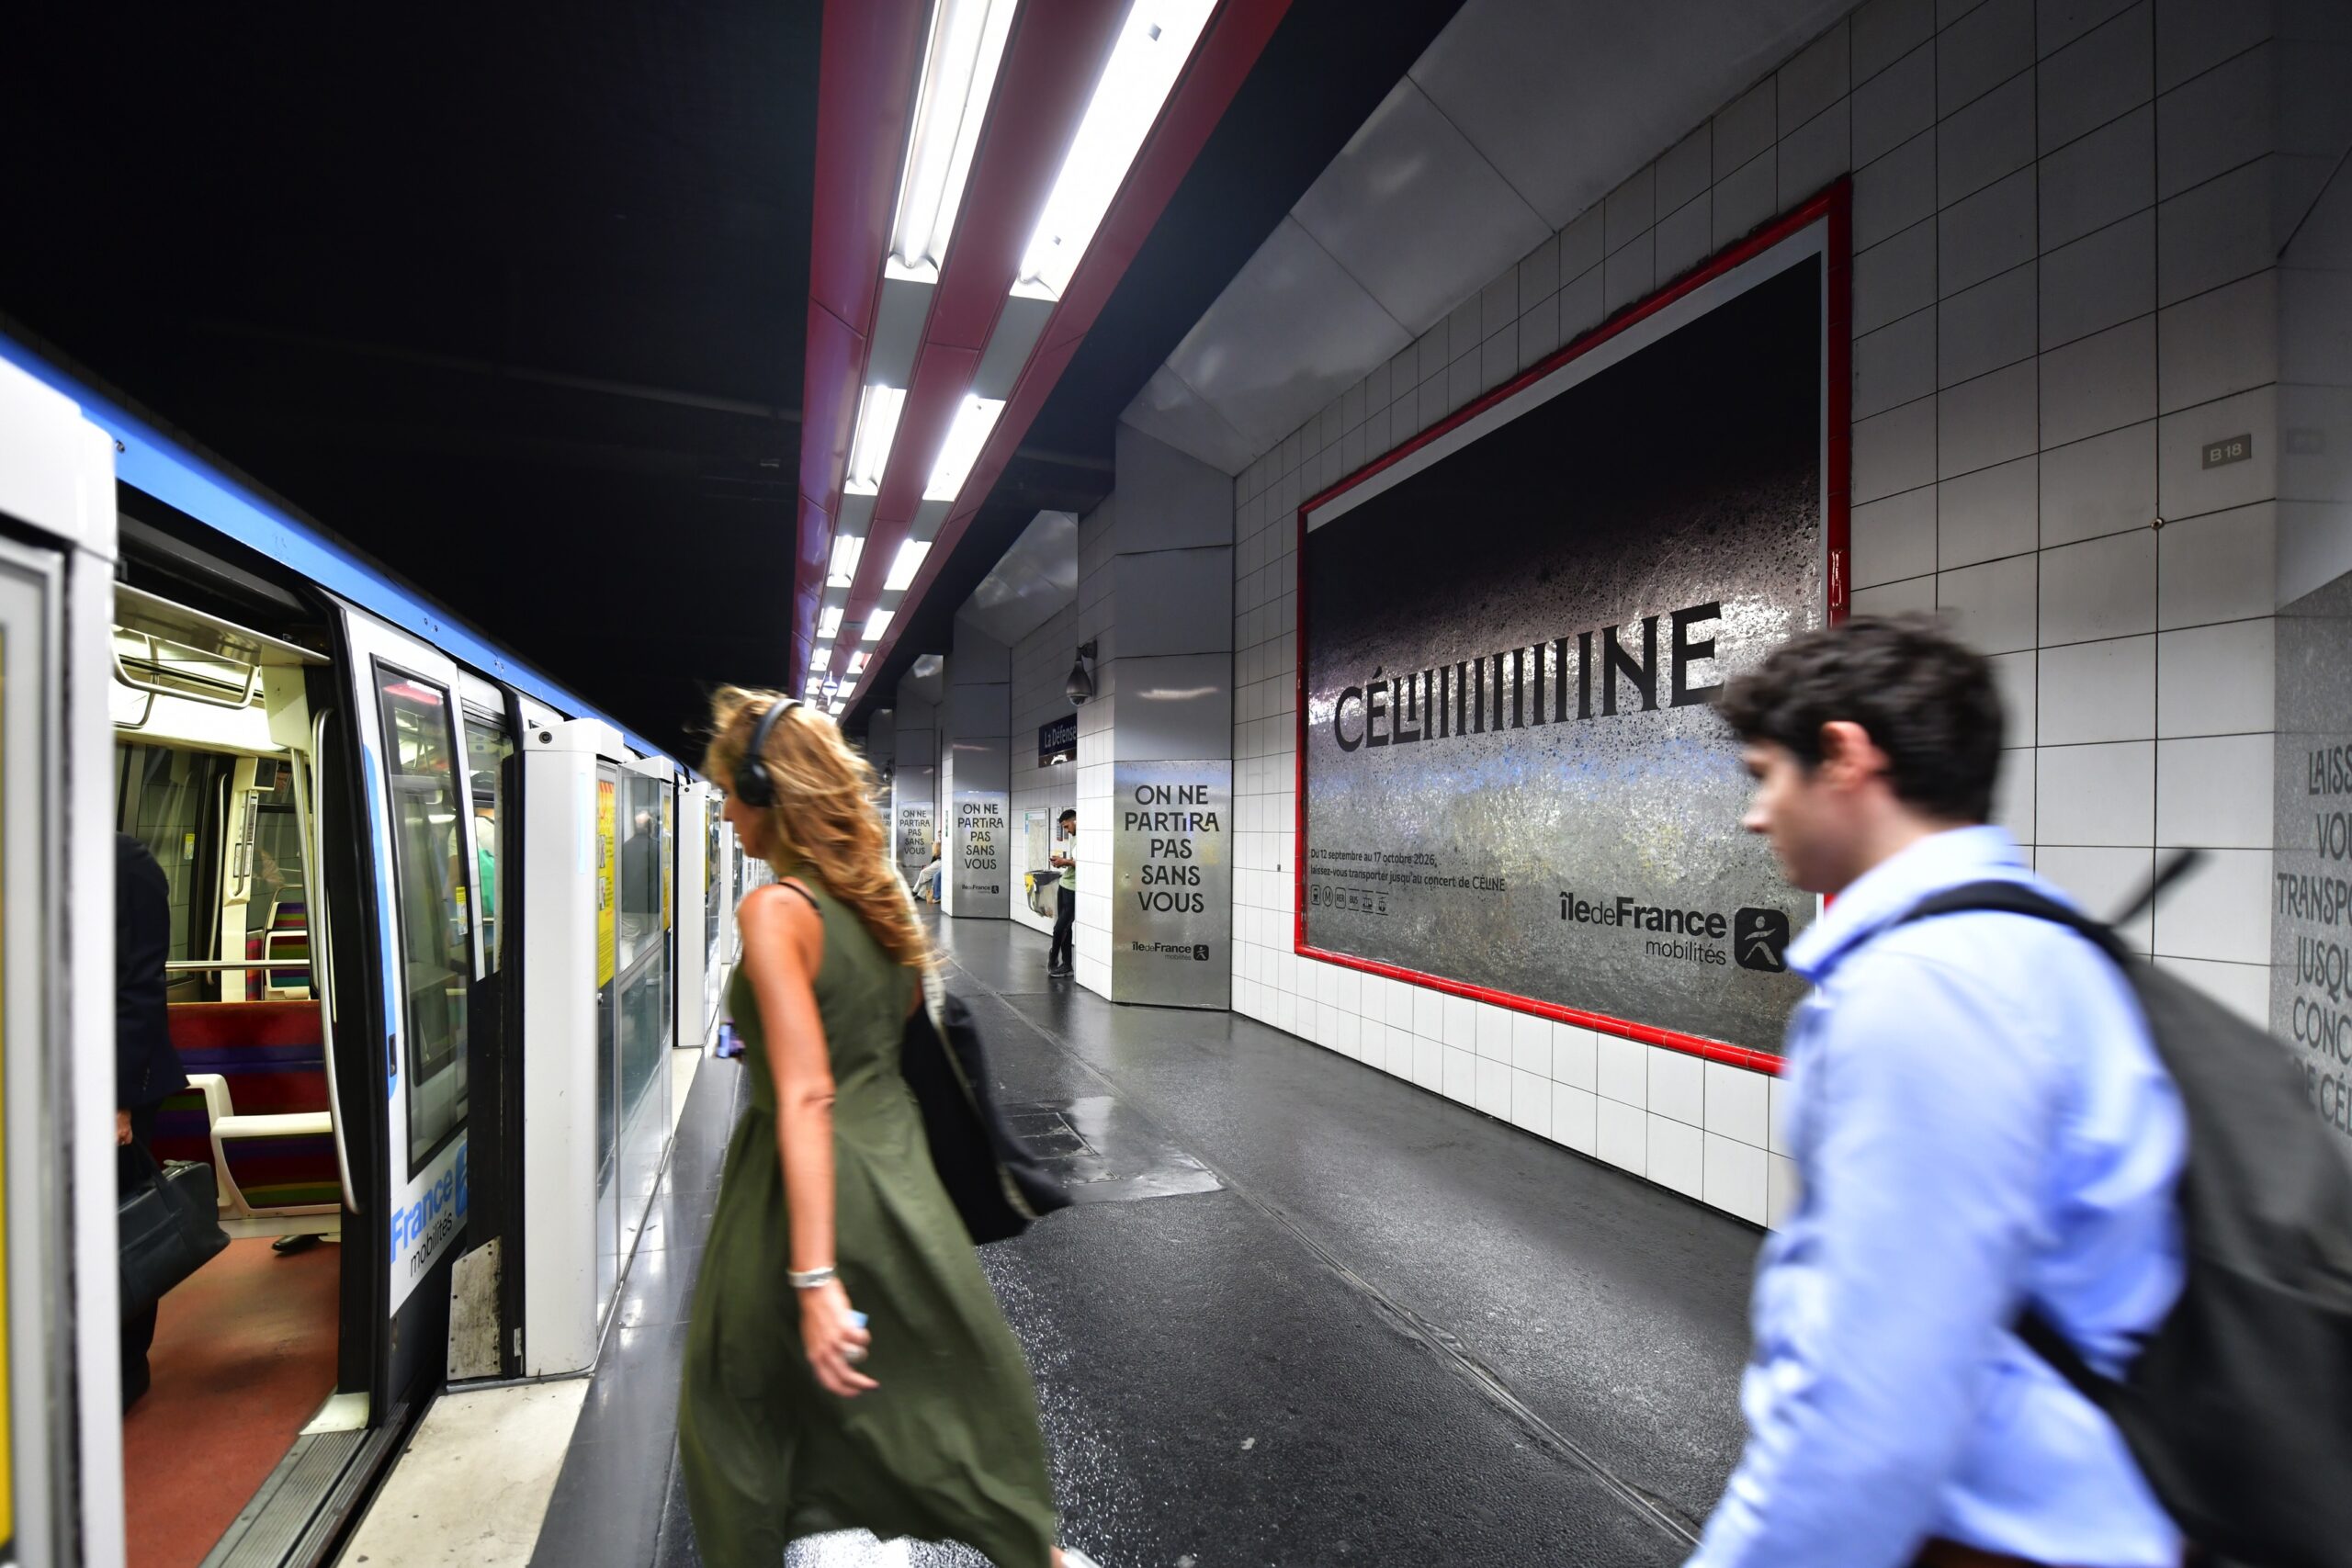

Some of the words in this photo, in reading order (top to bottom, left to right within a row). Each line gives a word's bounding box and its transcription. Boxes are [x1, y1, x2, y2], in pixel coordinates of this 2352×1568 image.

[2211, 448, 2222, 462] B
[2225, 443, 2243, 457] 18
[1045, 731, 1052, 749] La
[1052, 724, 1077, 746] Défense
[1135, 785, 1170, 805] ON
[1179, 785, 1208, 805] NE
[963, 804, 980, 814] ON
[984, 804, 998, 814] NE
[957, 818, 1004, 829] PARTIRA
[1125, 812, 1220, 832] PARTIRA
[905, 838, 924, 846] SANS
[908, 829, 922, 837] PAS
[970, 831, 991, 842] PAS
[904, 847, 925, 855] VOUS
[966, 845, 995, 855] SANS
[1150, 839, 1193, 859] PAS
[1310, 849, 1319, 859] Du
[1320, 850, 1328, 859] 12
[1329, 851, 1363, 862] septembre
[1374, 852, 1382, 862] 17
[1383, 852, 1412, 863] octobre
[965, 859, 997, 869] VOUS
[1141, 864, 1201, 886] SANS
[1310, 864, 1348, 877] laissez-vous
[1349, 868, 1388, 881] transporter
[1424, 875, 1456, 887] concert
[1458, 876, 1470, 888] de
[1472, 874, 1506, 891] CÉLINE
[1137, 891, 1204, 913] VOUS
[1645, 939, 1726, 965] mobilités
[390, 1168, 453, 1265] France
[411, 1211, 452, 1278] mobilités
